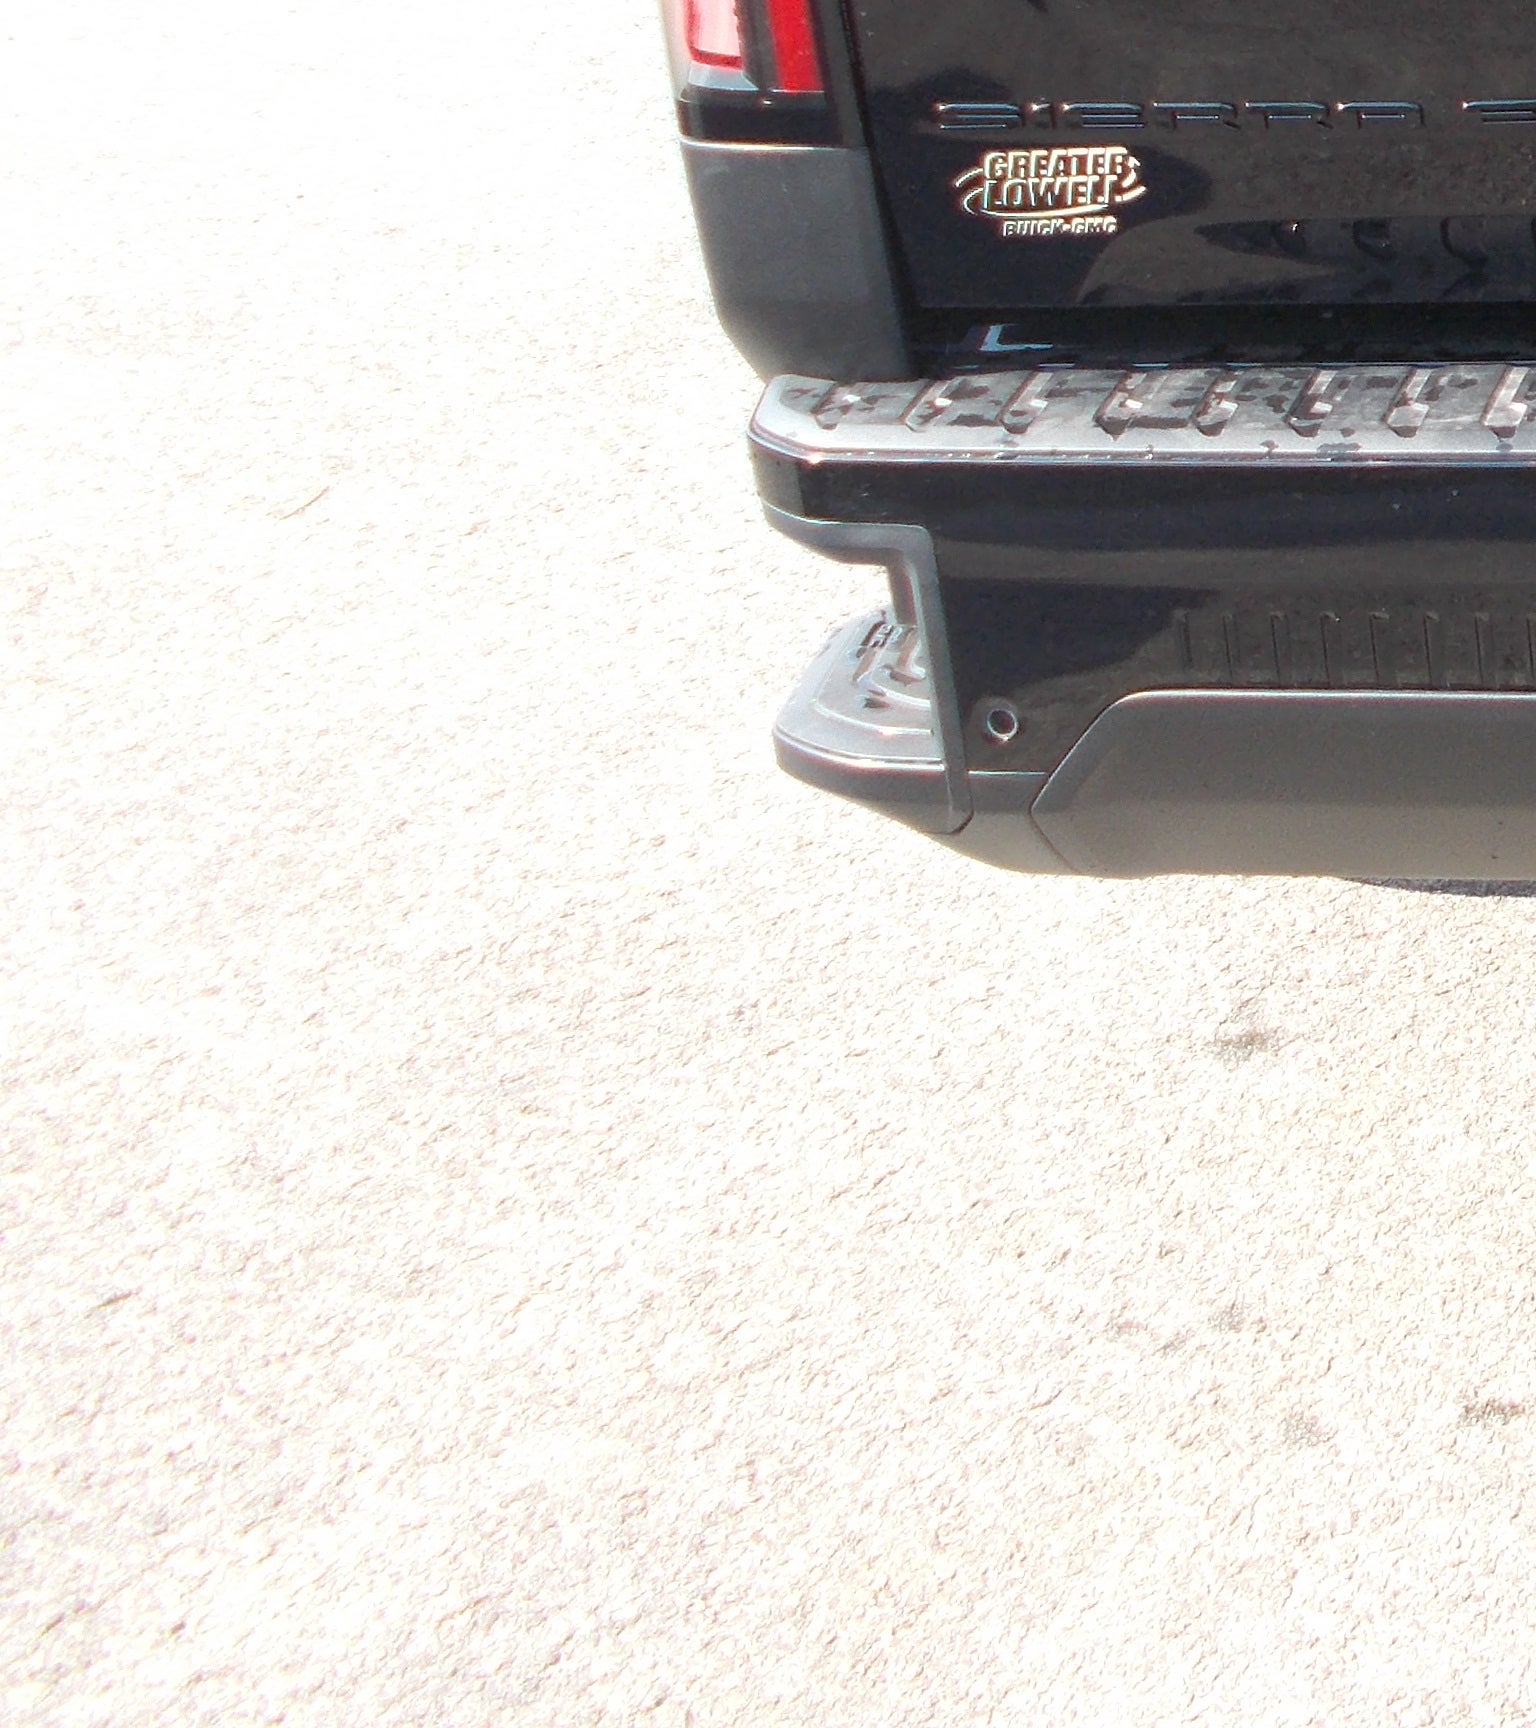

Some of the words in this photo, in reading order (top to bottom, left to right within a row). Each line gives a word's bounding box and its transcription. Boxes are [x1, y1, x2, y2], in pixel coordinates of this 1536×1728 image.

[935, 97, 1426, 131] SIERRA
[982, 144, 1130, 180] GREATER
[981, 173, 1124, 210] LOWELL
